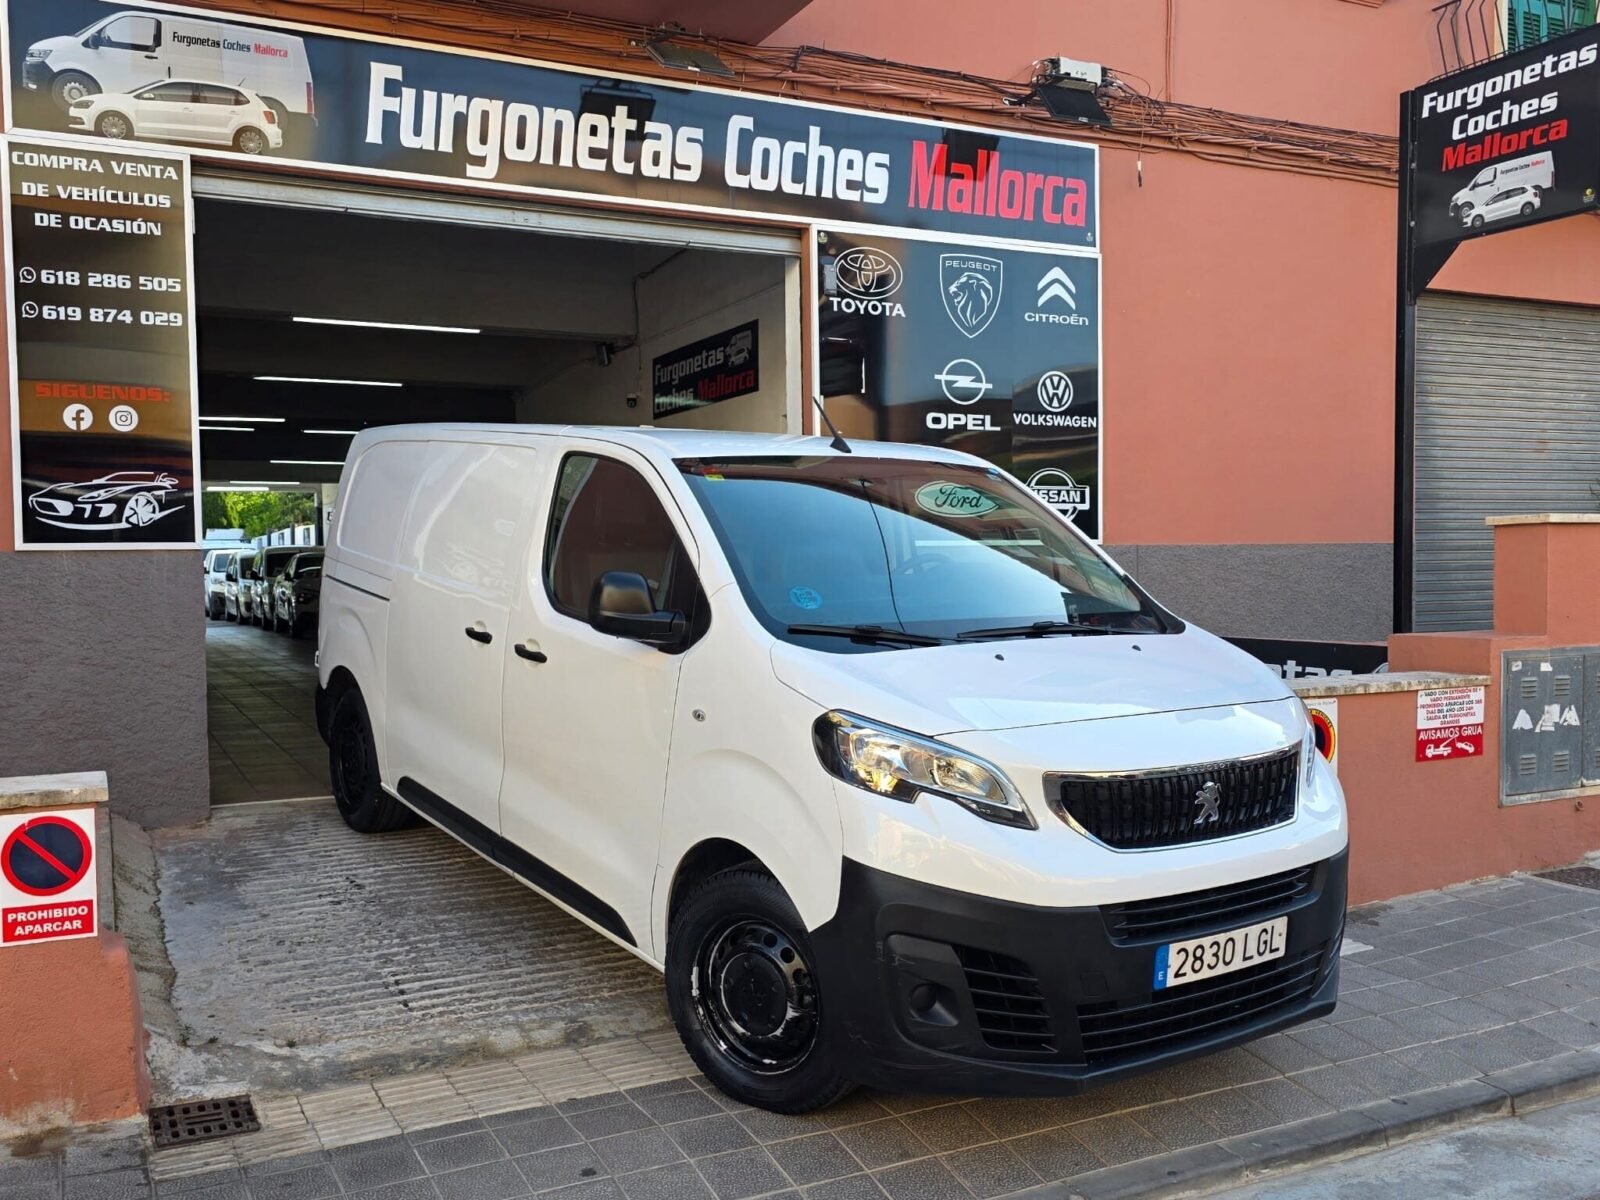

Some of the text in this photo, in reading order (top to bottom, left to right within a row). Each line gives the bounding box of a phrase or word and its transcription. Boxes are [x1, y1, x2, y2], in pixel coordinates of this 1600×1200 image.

[172, 31, 289, 58] Furgonetas Coches Mallorca
[1421, 43, 1598, 119] Furgonetas
[1452, 91, 1559, 141] Coches
[365, 61, 1087, 227] Furgonetas Coches Mallorca
[1441, 118, 1568, 172] Mallorca
[12, 151, 179, 181] COMPRA VENTA
[21, 181, 171, 208] DE VEHÍCULOS
[34, 212, 162, 236] DE OCASIÓN
[945, 260, 998, 273] PEUGEOT
[40, 269, 182, 292] 618 286 505
[42, 305, 183, 327] 619 874 029
[829, 297, 906, 318] TOYOTA
[655, 346, 725, 386] Furgonetas
[35, 383, 172, 402] SIGUENOS:
[654, 368, 755, 414] Coches Mallorca
[925, 412, 1001, 431] OPEL
[1013, 412, 1097, 429] VOLKSWAGEN
[934, 482, 982, 508] Ford
[1034, 489, 1081, 503] SSAN
[1418, 725, 1483, 741] AVISAMOS GRUA
[7, 905, 89, 923] PROHIBIDO
[14, 919, 83, 936] APARCAR
[1173, 925, 1280, 979] 2830 LGL
[1158, 971, 1164, 980] E
